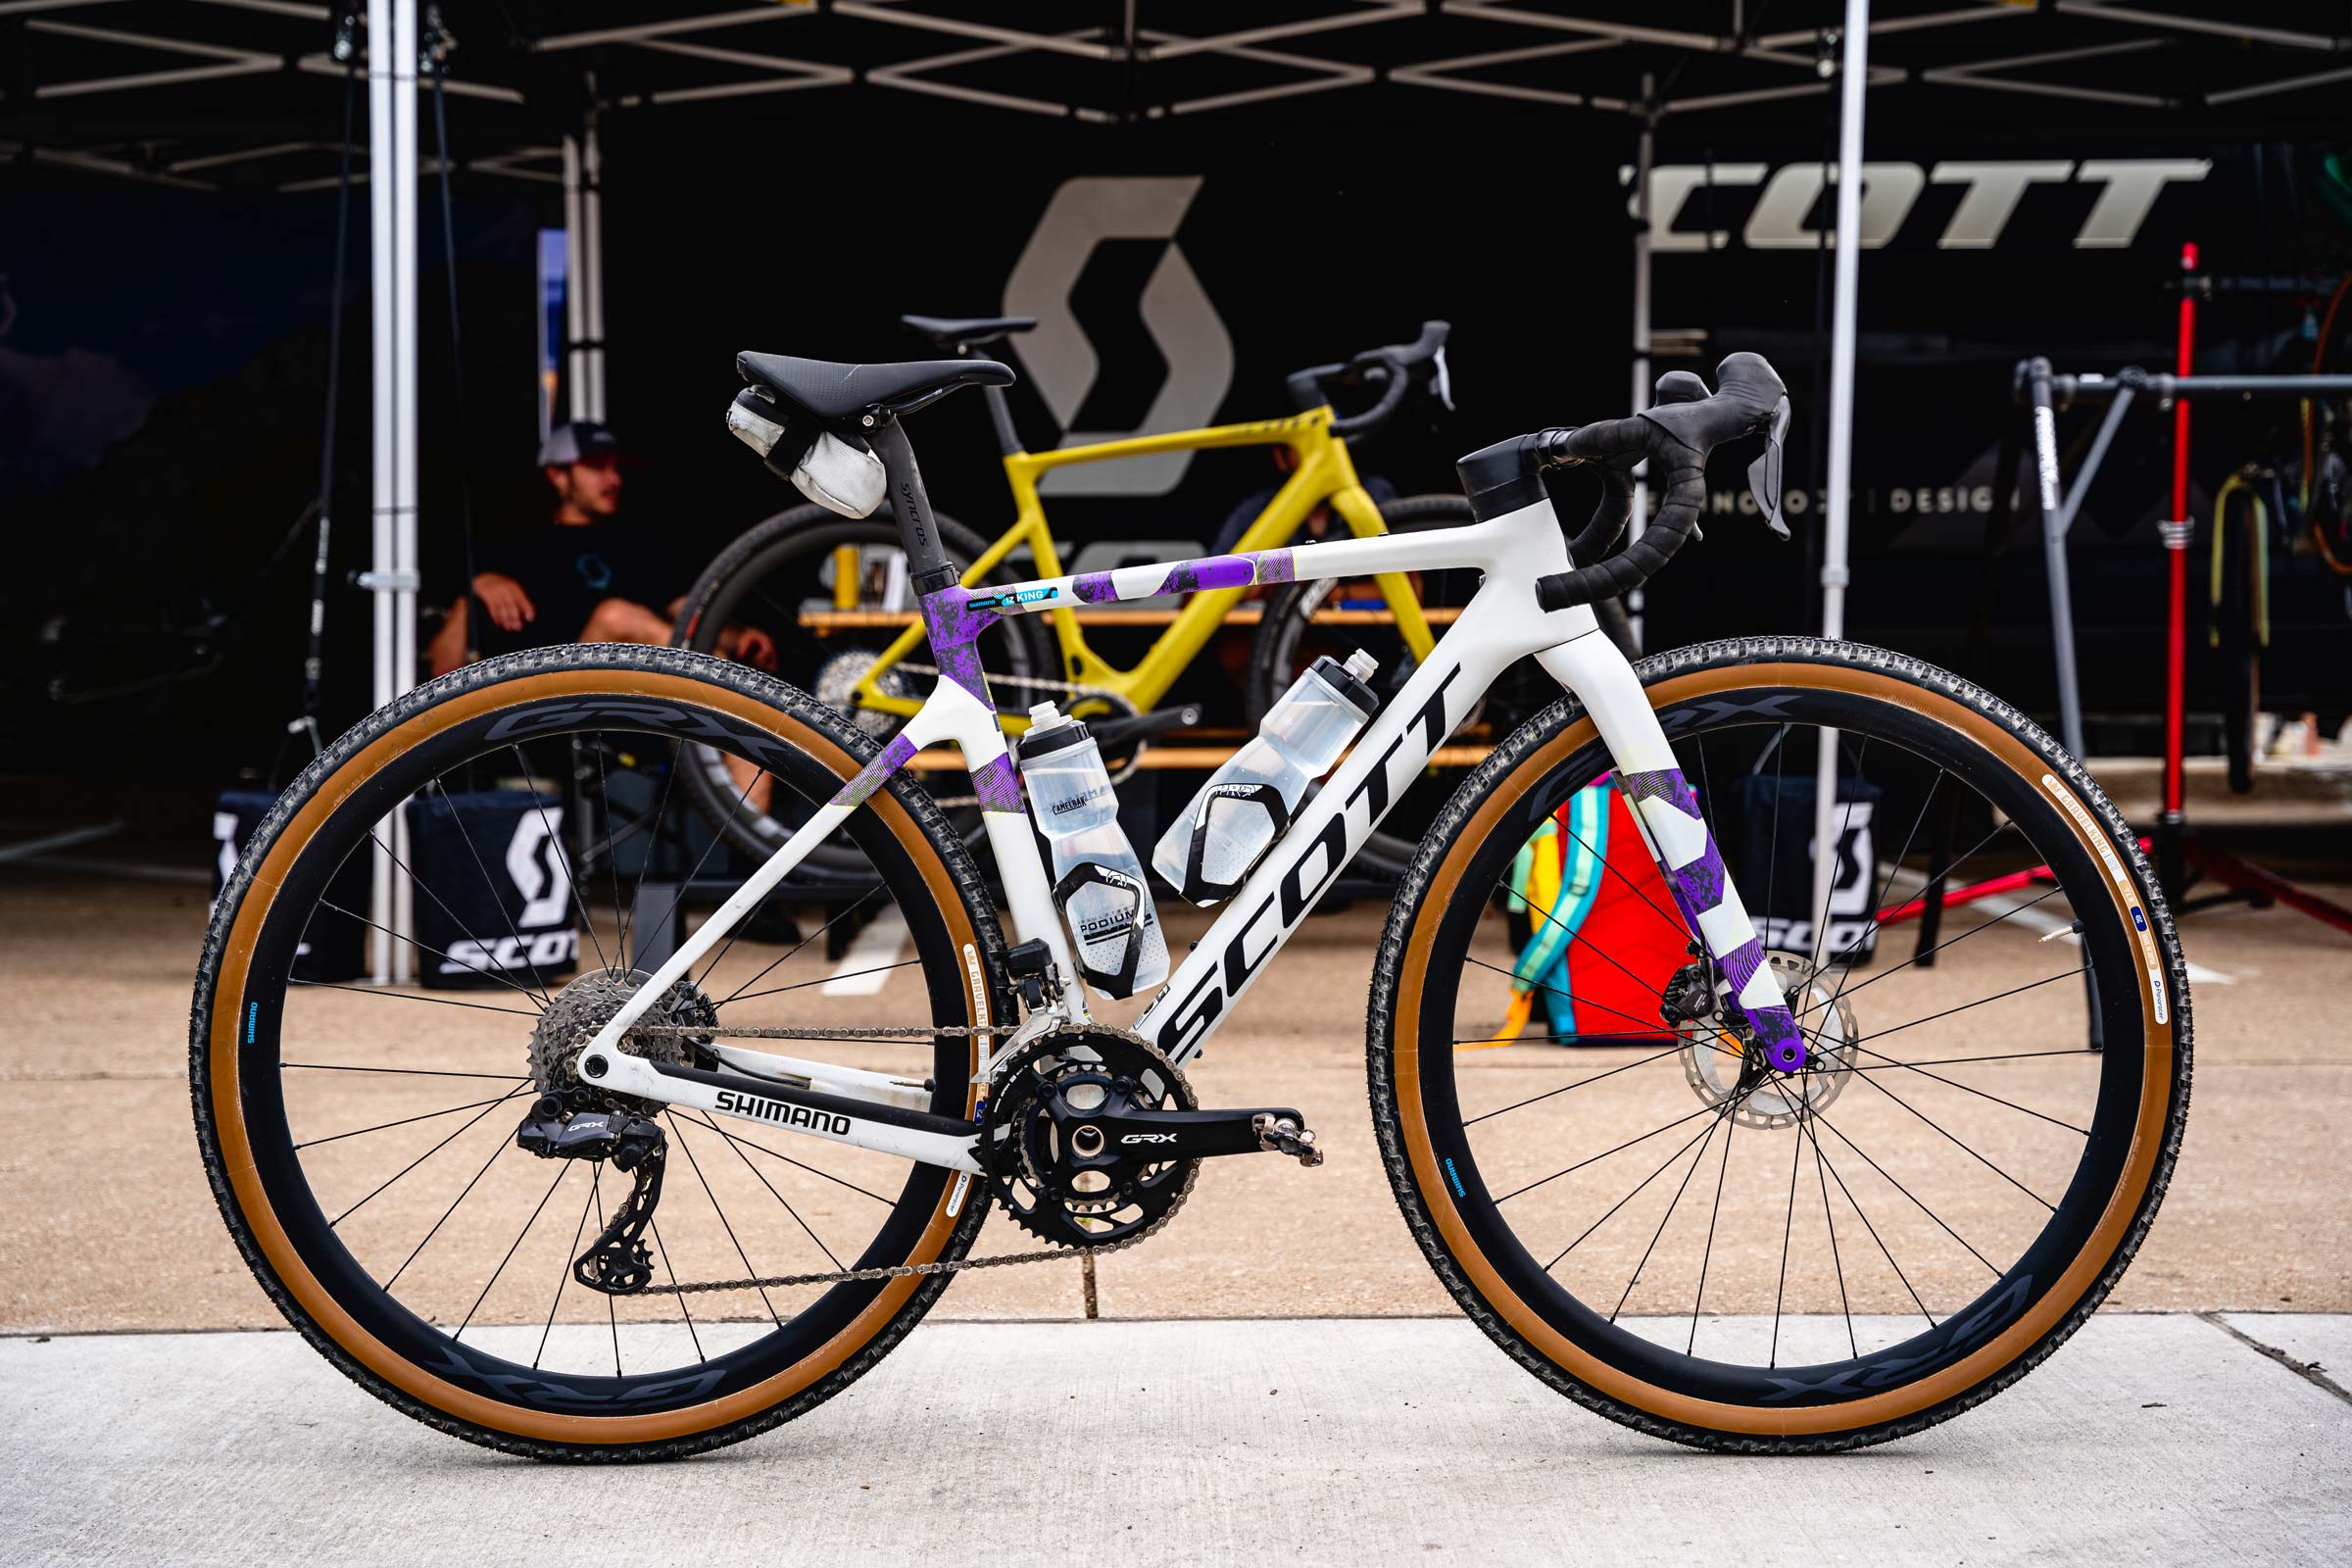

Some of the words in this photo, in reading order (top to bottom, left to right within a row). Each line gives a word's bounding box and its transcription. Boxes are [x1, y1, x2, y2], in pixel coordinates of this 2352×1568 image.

[1619, 160, 2212, 251] COTT
[1016, 590, 1044, 603] KING
[483, 701, 788, 765] GRX
[1052, 795, 1088, 815] CAMELBAK
[2061, 795, 2108, 854] GRAVELKING
[1157, 662, 1462, 1066] SCOTT
[1080, 908, 1135, 933] PODIUM
[247, 1002, 259, 1044] SHIMANO
[970, 971, 989, 1040] GRAVELKI
[567, 1120, 605, 1133] GRX
[715, 1091, 852, 1138] SHIMANO
[1120, 1133, 1178, 1145] GRX
[1445, 1157, 1466, 1199] SHIMANO
